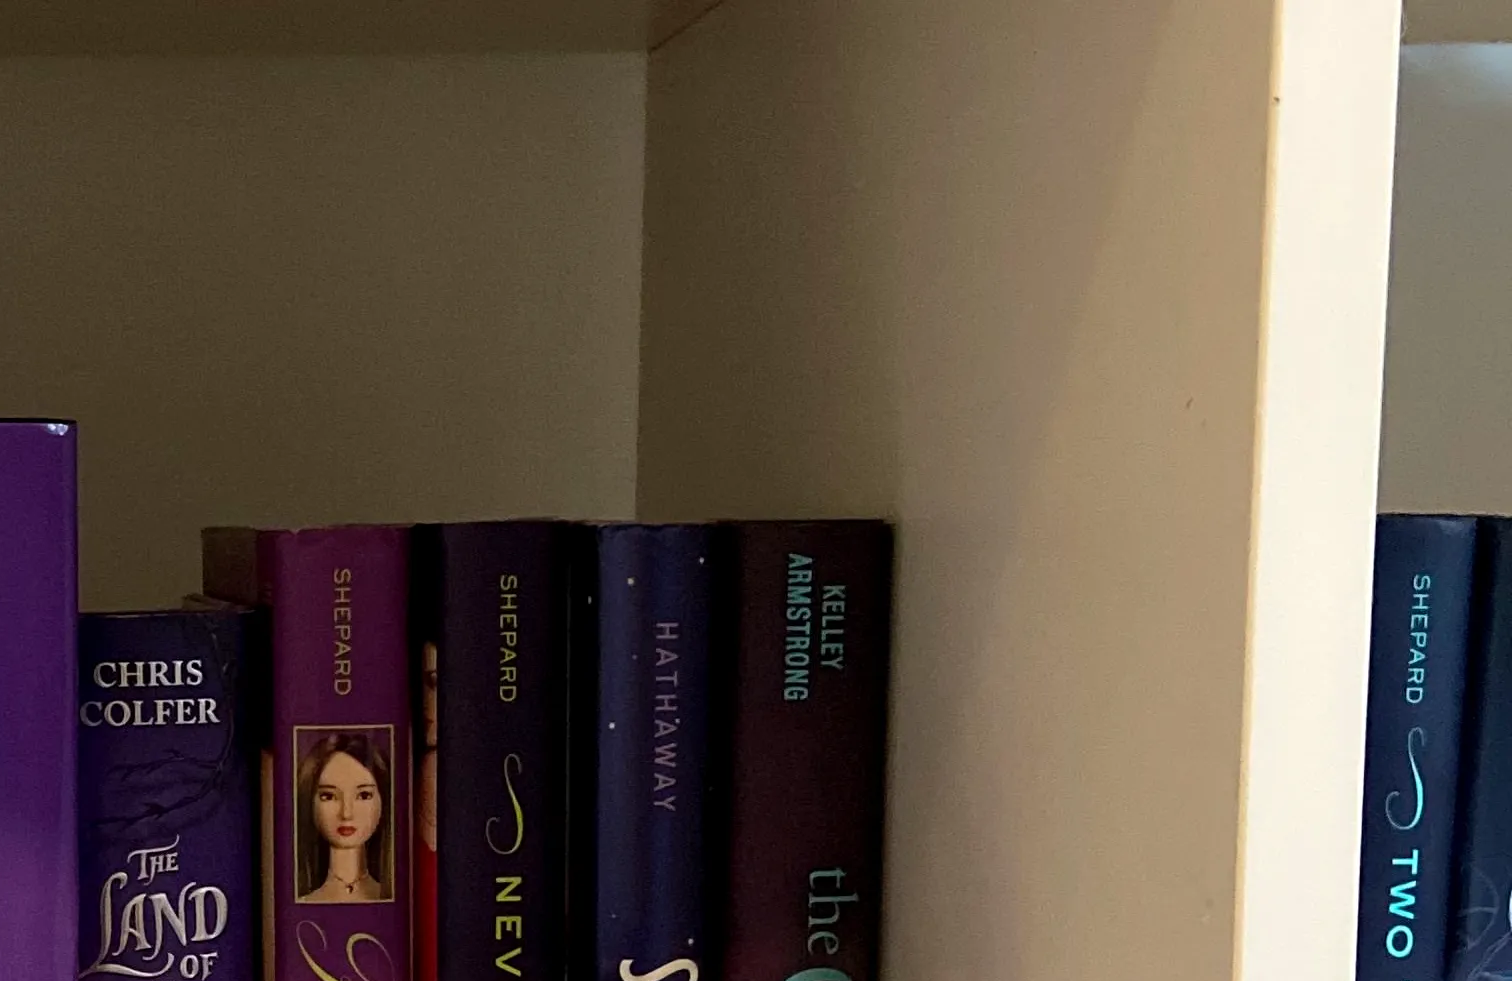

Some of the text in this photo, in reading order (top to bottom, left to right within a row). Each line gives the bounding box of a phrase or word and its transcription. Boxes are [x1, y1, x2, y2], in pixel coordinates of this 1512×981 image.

[93, 659, 203, 688] CHRIS
[333, 567, 352, 696] SHEPARD
[498, 573, 519, 703] SHEPARD
[783, 553, 814, 701] ARMSTRONG
[820, 585, 846, 670] KELLEY
[1405, 573, 1431, 704] SHEPARD
[79, 698, 221, 727] COLFER
[652, 620, 680, 813] HATHAWAY
[78, 871, 229, 979] LAND
[807, 867, 860, 956] the
[1386, 849, 1420, 960] TWO
[179, 952, 218, 981] OF
